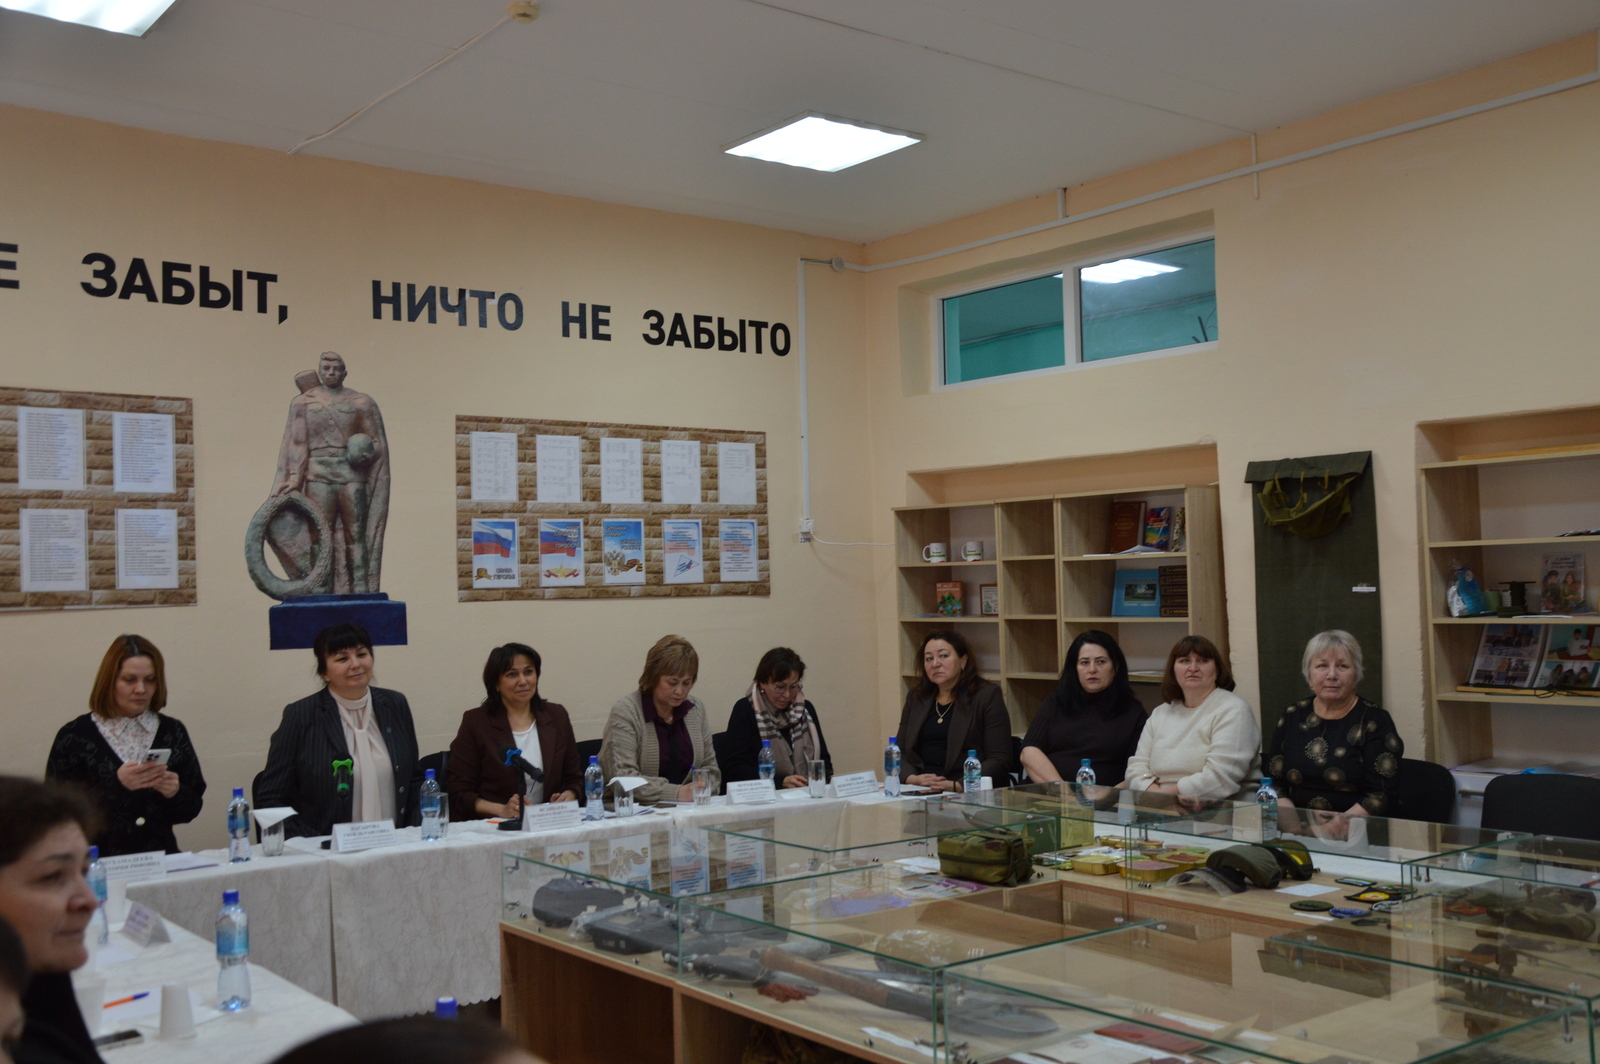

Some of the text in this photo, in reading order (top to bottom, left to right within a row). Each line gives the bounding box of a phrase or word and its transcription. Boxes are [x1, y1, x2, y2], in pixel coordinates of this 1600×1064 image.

[80, 252, 288, 325] ЗАБЫТ,
[372, 279, 524, 331] НИЧТО
[561, 301, 612, 342] НЕ
[642, 309, 791, 357] ЗАБЫТО
